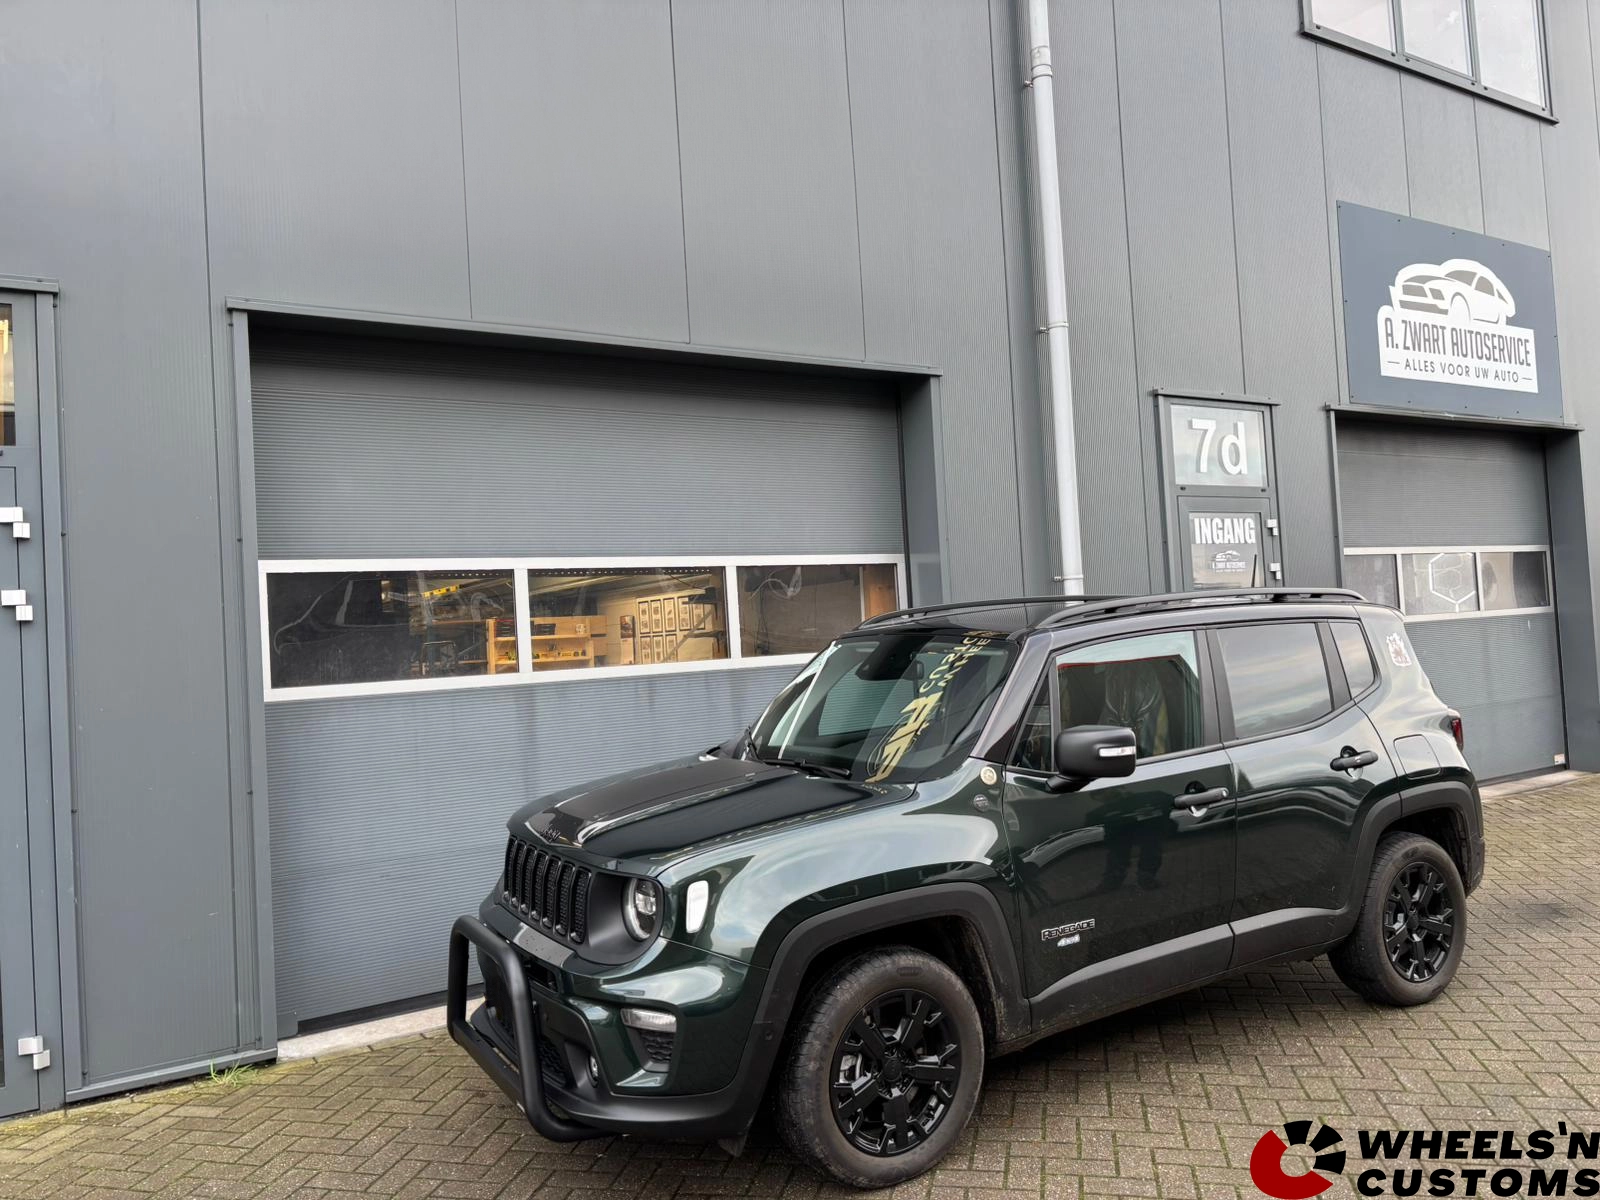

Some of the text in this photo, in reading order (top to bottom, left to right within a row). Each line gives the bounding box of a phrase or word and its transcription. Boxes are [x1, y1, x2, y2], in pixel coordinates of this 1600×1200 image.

[1384, 317, 1531, 367] A. ZWART AUTOSERVICE
[1404, 358, 1519, 383] ALLES VOOR UW AUTO
[1191, 418, 1248, 475] 7d
[1194, 517, 1256, 544] INGANG
[1041, 918, 1095, 941] RENEGADE
